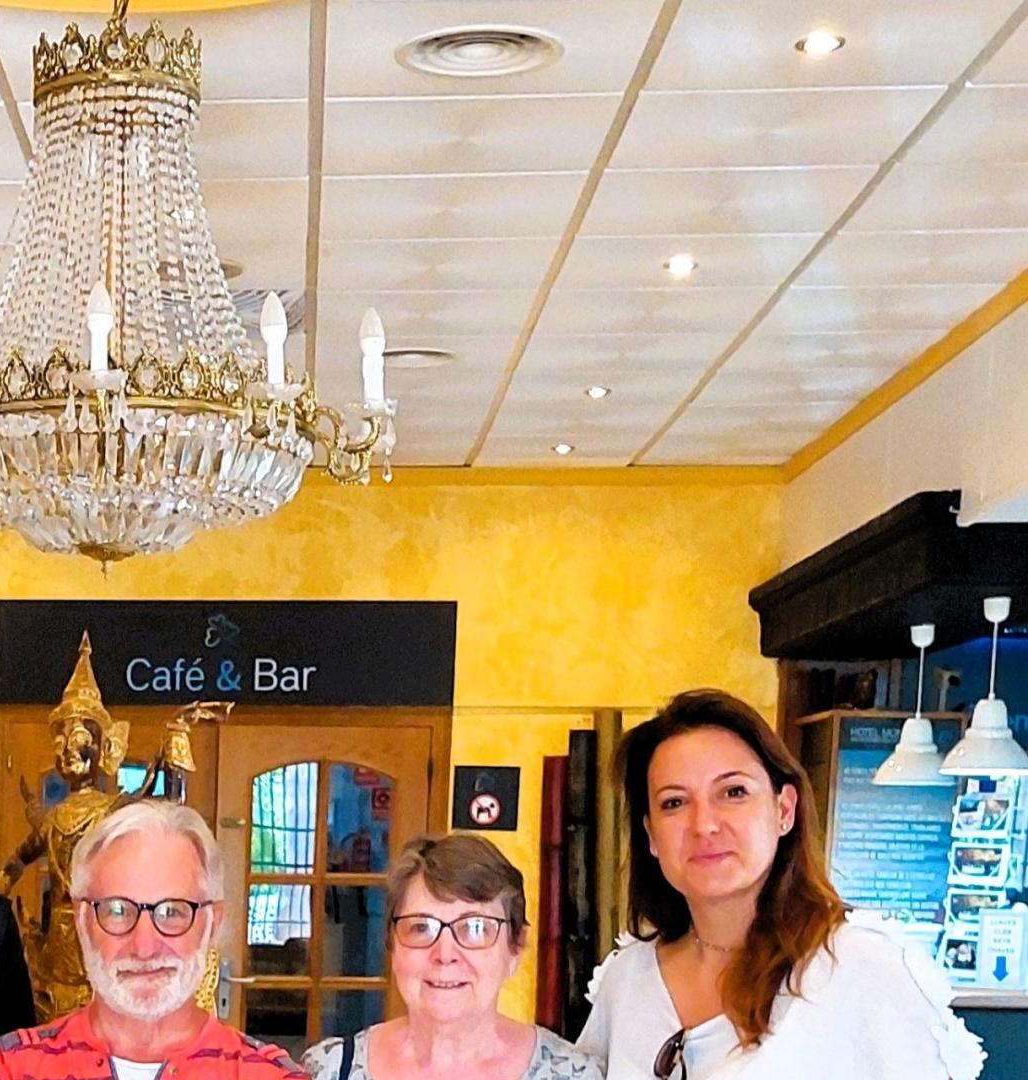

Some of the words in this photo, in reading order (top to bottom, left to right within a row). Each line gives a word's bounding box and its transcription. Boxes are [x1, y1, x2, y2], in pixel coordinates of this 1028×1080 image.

[126, 657, 205, 691] Café
[216, 660, 242, 691] &
[254, 658, 317, 691] Bar
